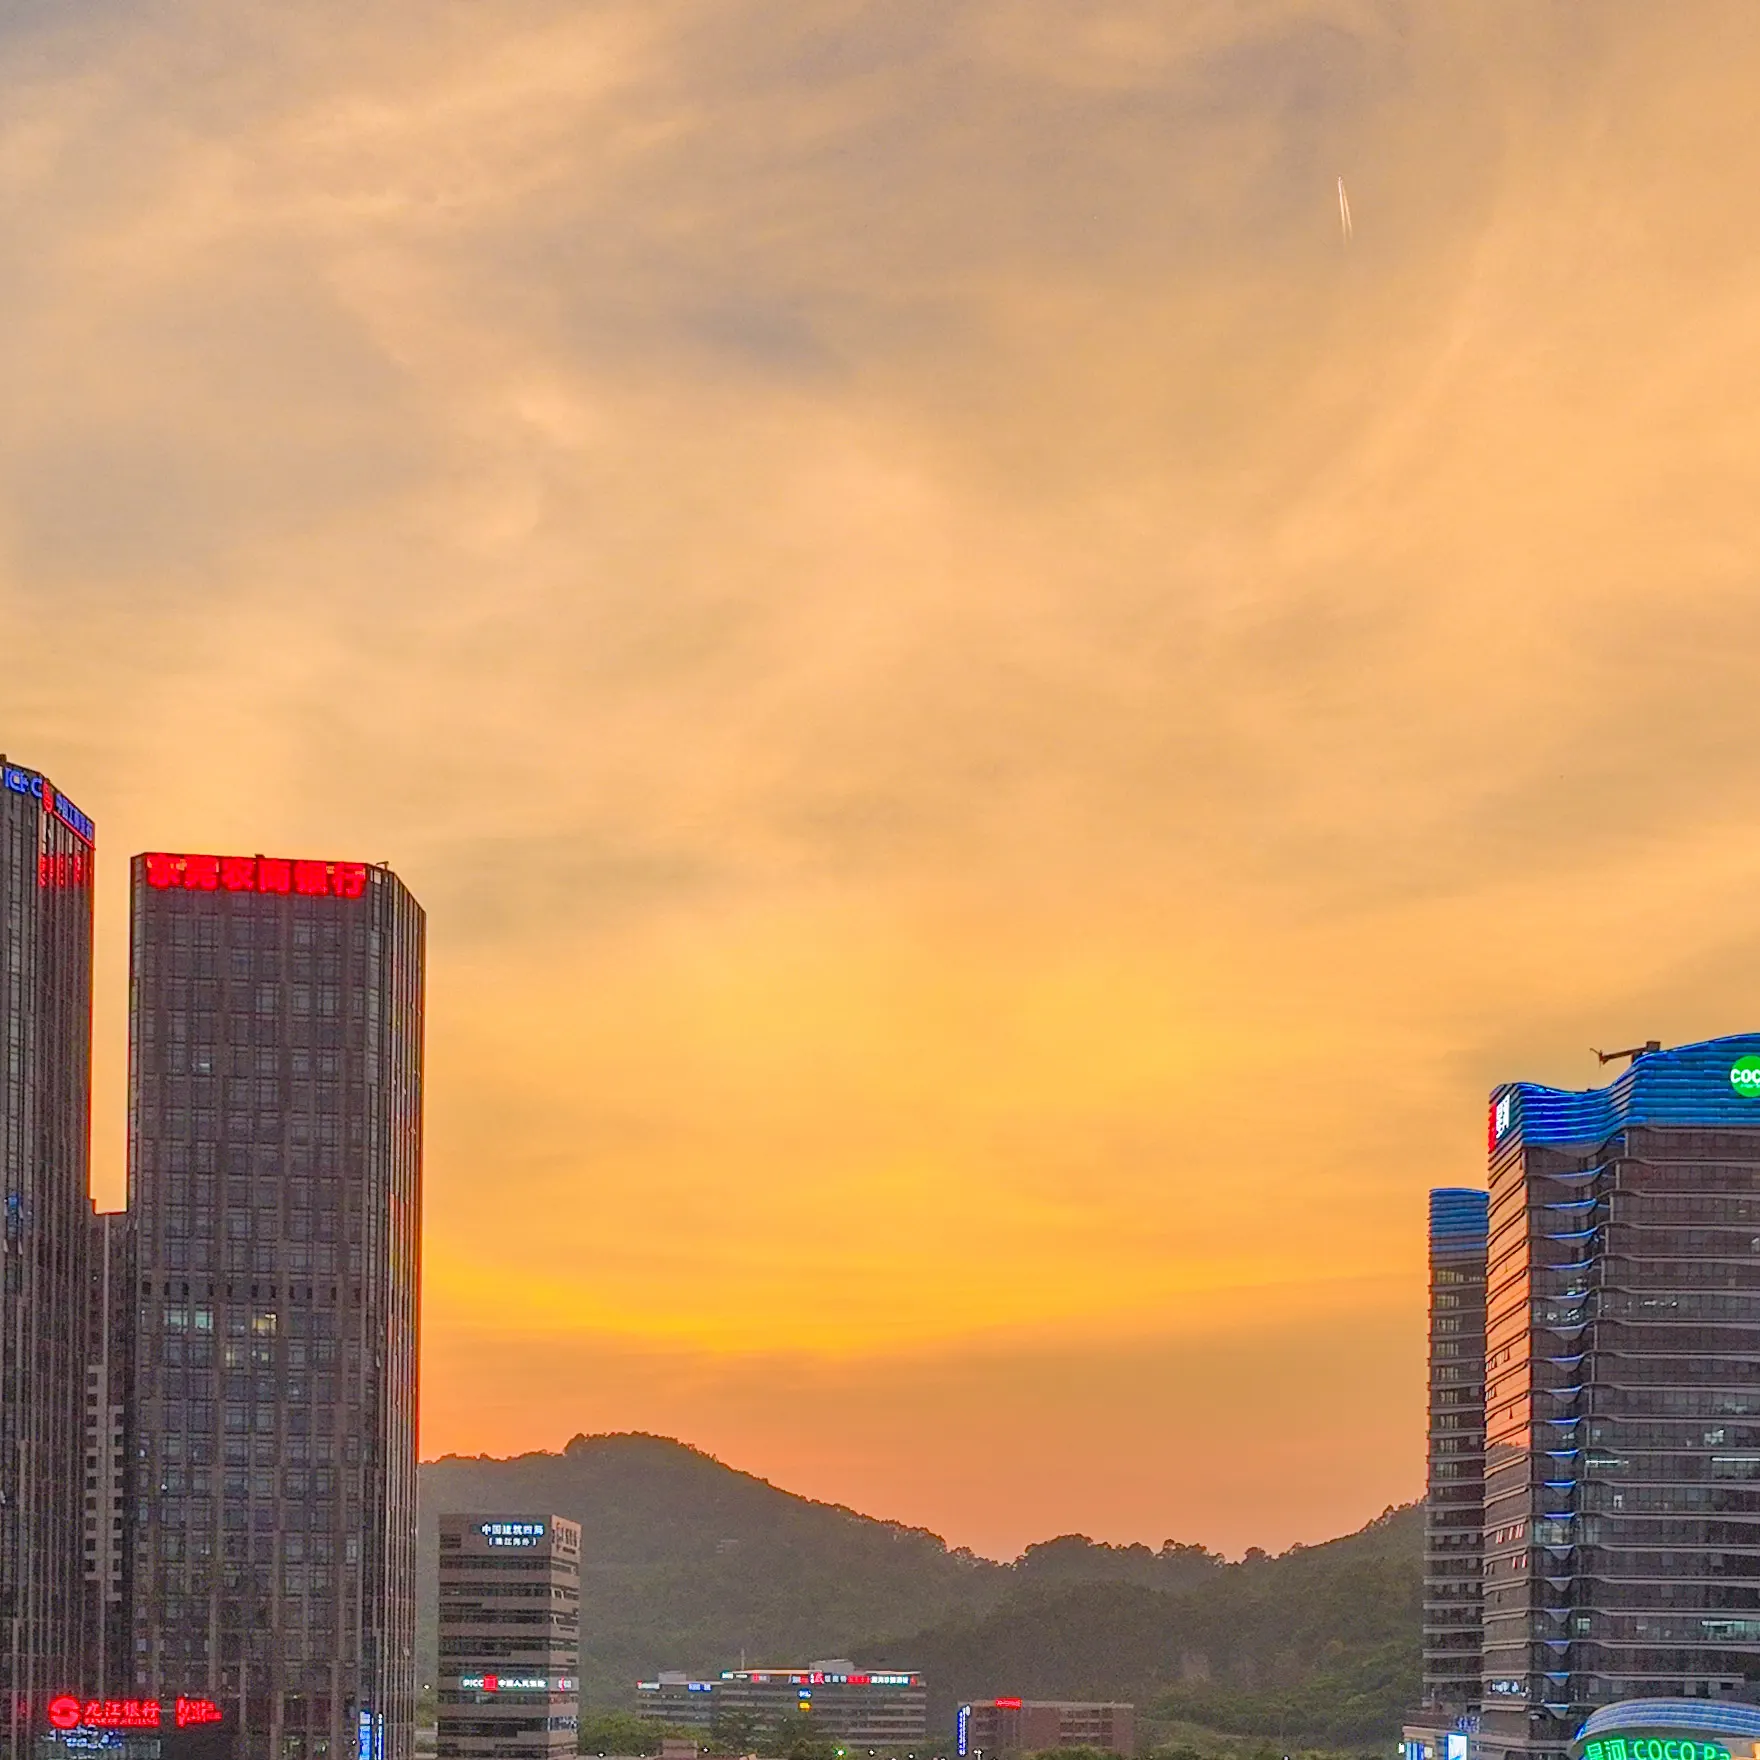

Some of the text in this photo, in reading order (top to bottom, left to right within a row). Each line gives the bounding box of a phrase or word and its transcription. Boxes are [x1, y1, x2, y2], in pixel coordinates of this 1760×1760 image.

[147, 855, 365, 897] 东莞农商银行
[85, 1700, 161, 1717] 九江银行
